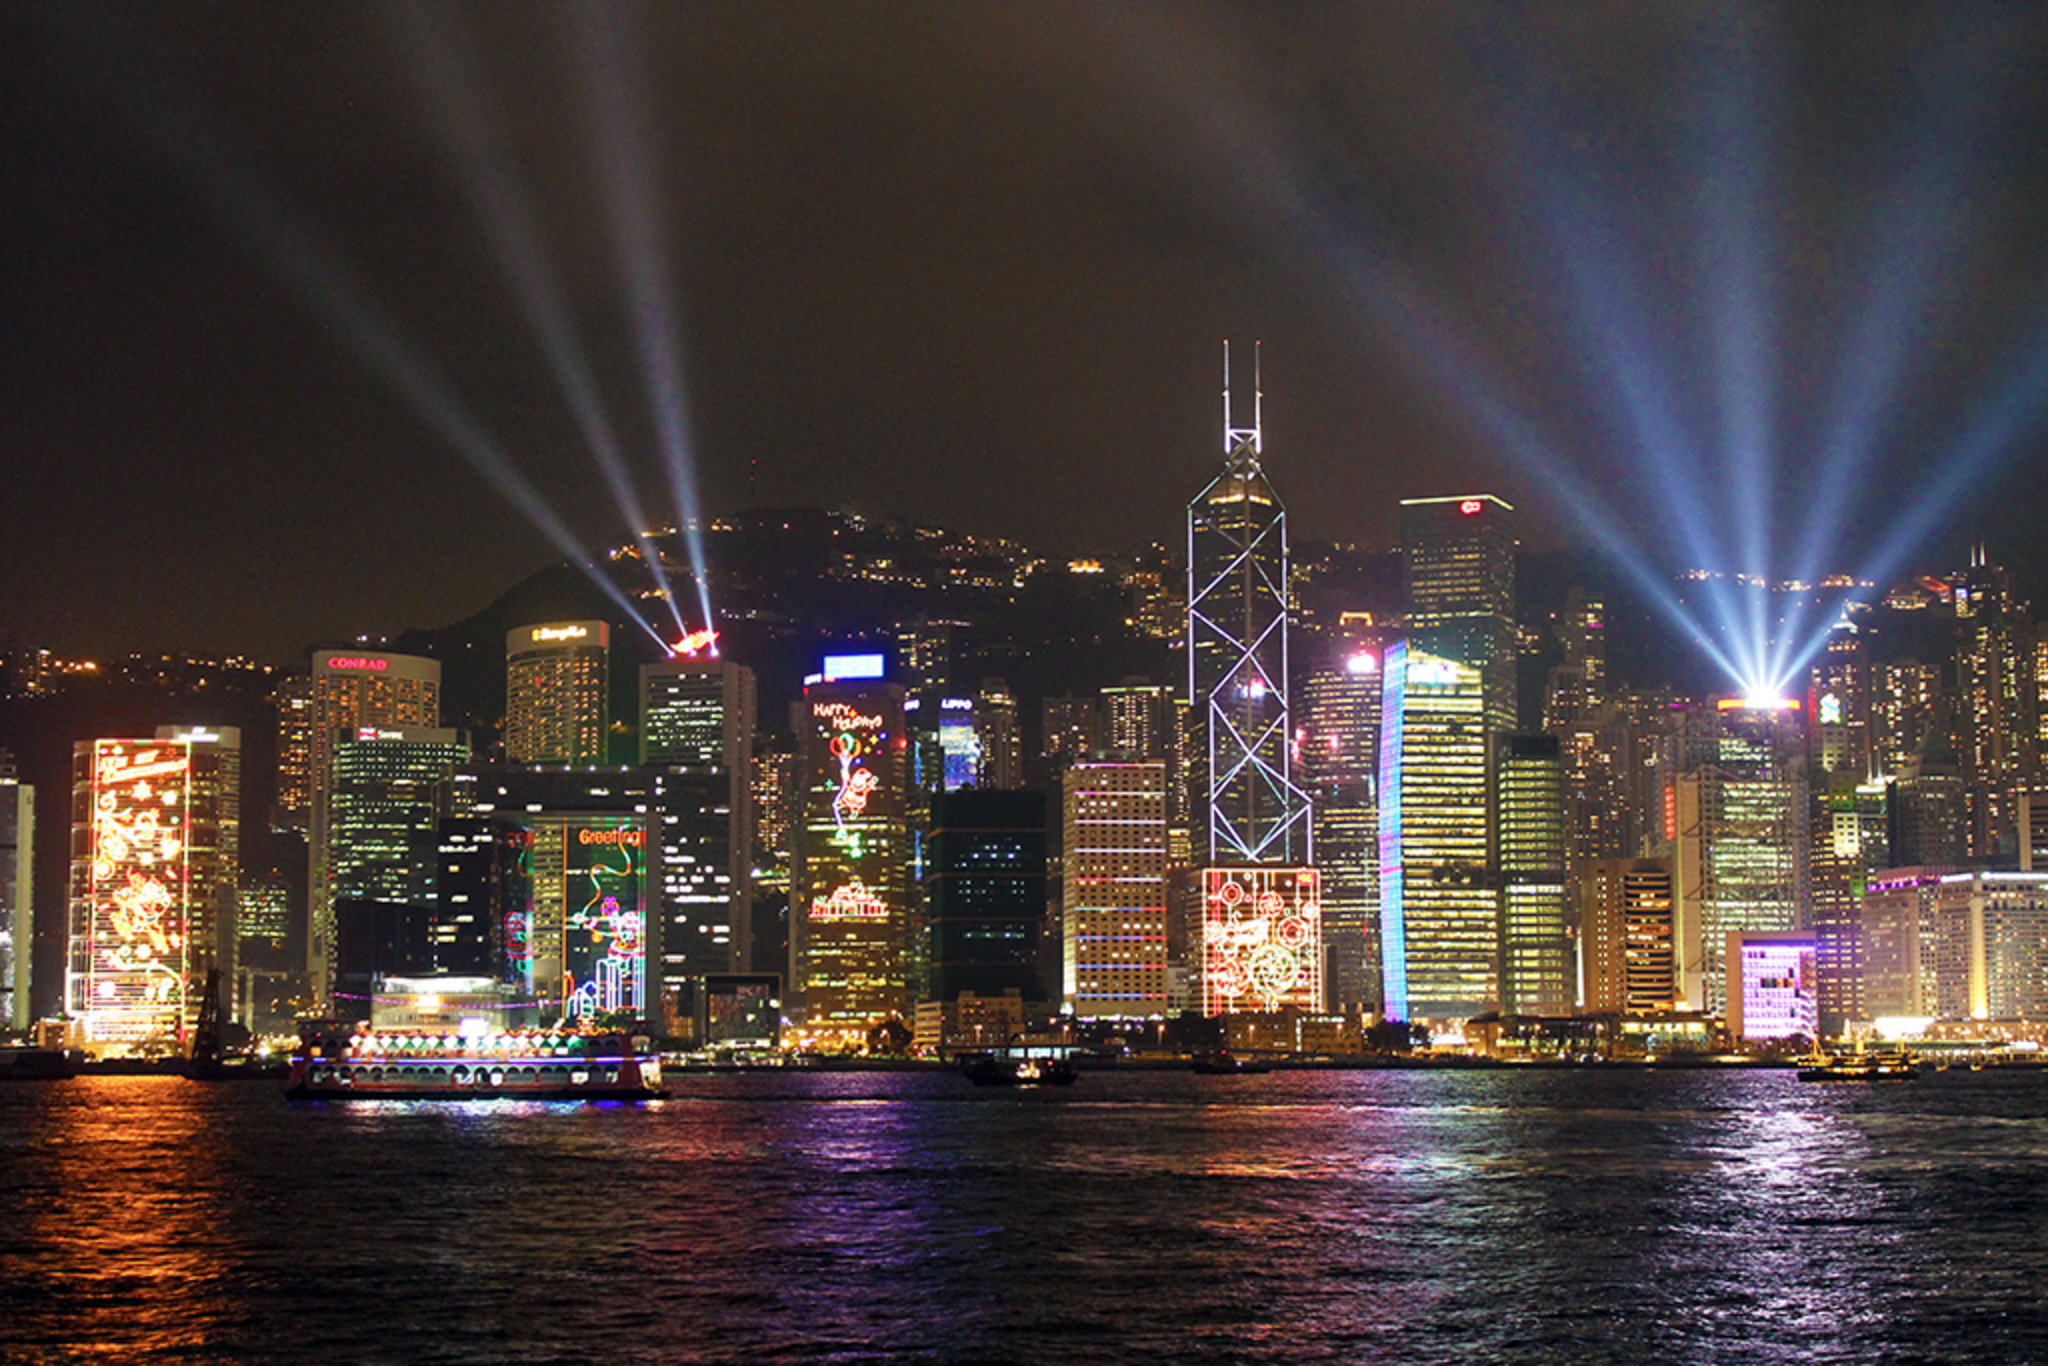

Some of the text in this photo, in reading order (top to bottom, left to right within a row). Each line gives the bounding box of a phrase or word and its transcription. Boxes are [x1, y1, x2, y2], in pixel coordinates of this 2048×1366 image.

[328, 657, 388, 671] CONRAD
[813, 703, 851, 717] HAPPY
[941, 698, 973, 710] LIPPO
[832, 715, 883, 731] HOLIDAYS
